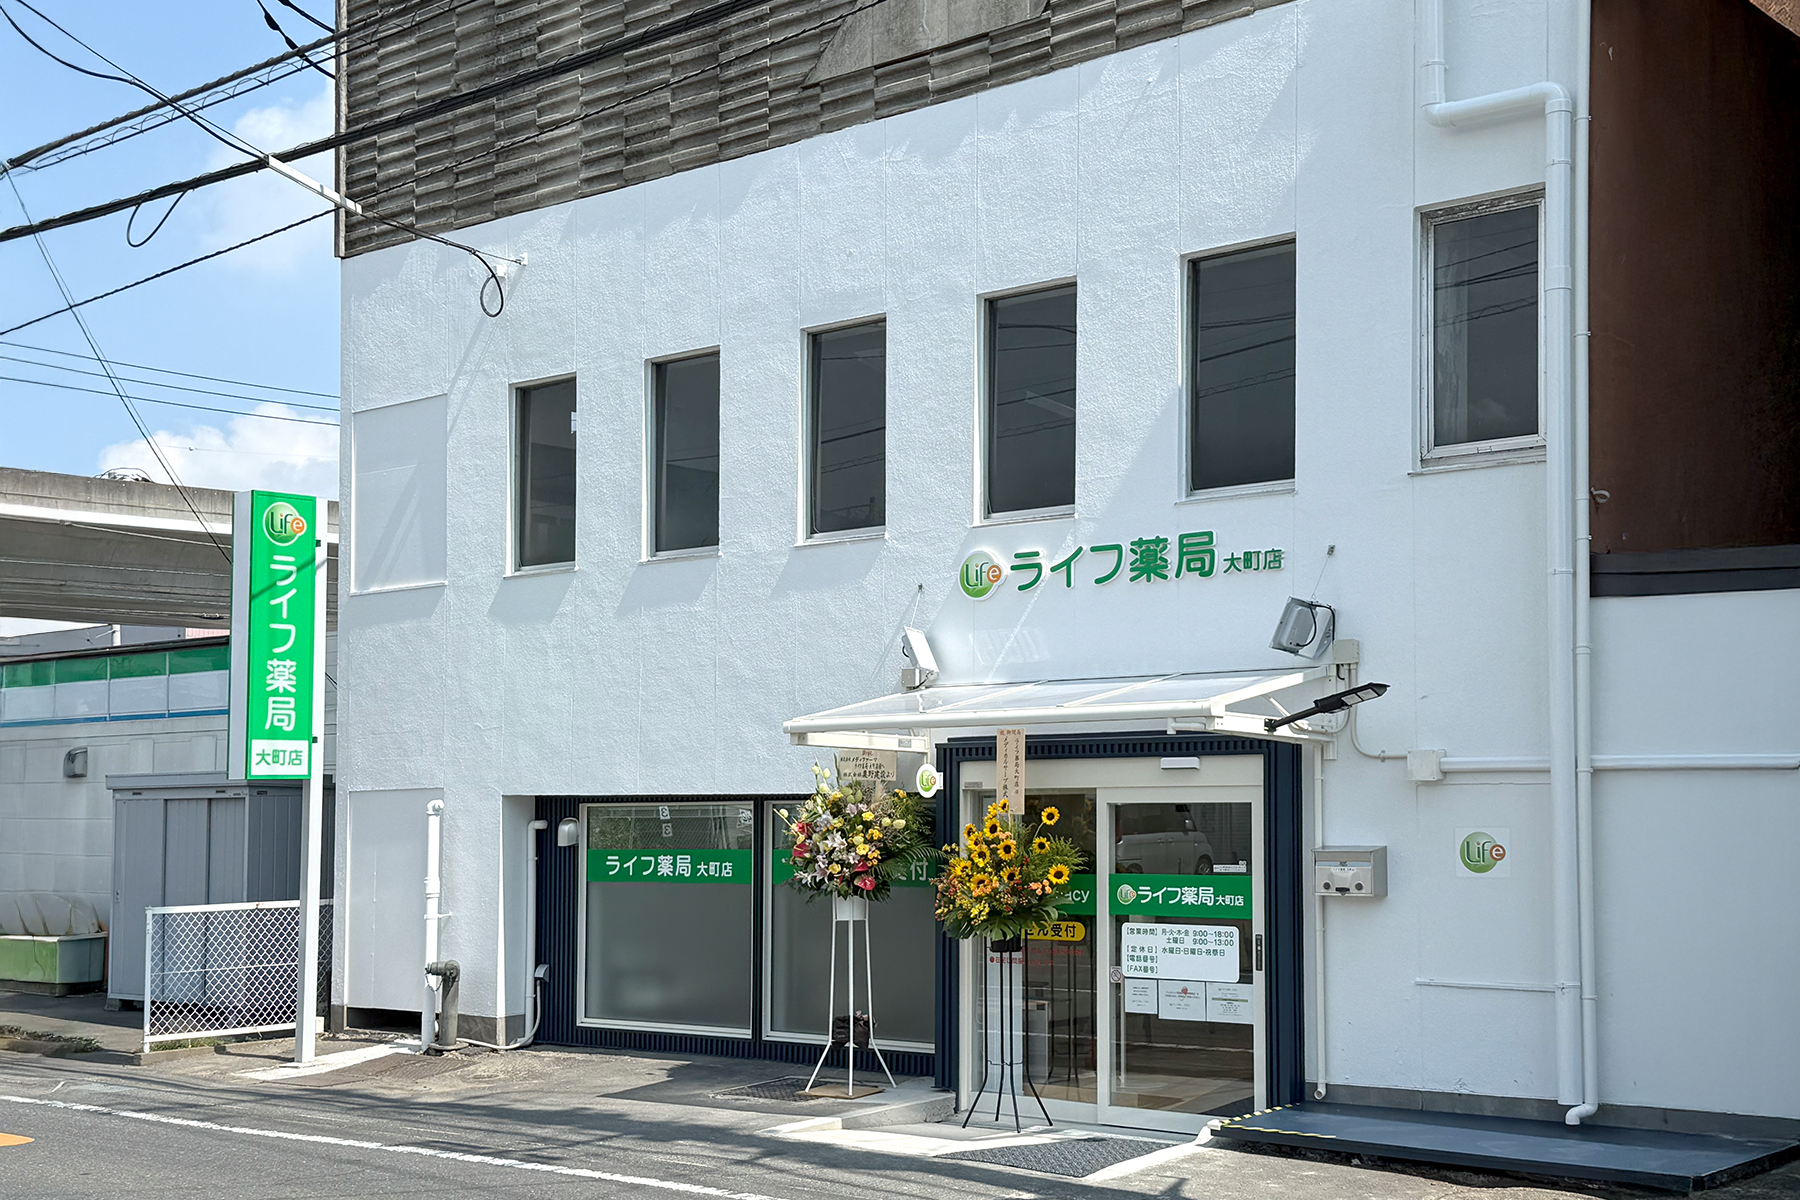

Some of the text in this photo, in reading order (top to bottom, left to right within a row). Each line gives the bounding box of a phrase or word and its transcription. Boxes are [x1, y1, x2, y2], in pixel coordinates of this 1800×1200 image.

[270, 510, 304, 535] Life
[1010, 530, 1284, 592] ライフ薬局 大町店
[964, 560, 1003, 589] Life
[264, 554, 298, 732] ライフ薬局
[255, 748, 303, 766] 大町店
[1465, 840, 1505, 865] Life
[605, 855, 733, 877] ライフ薬局 大町店
[1137, 886, 1244, 906] ライフ薬局 大町店
